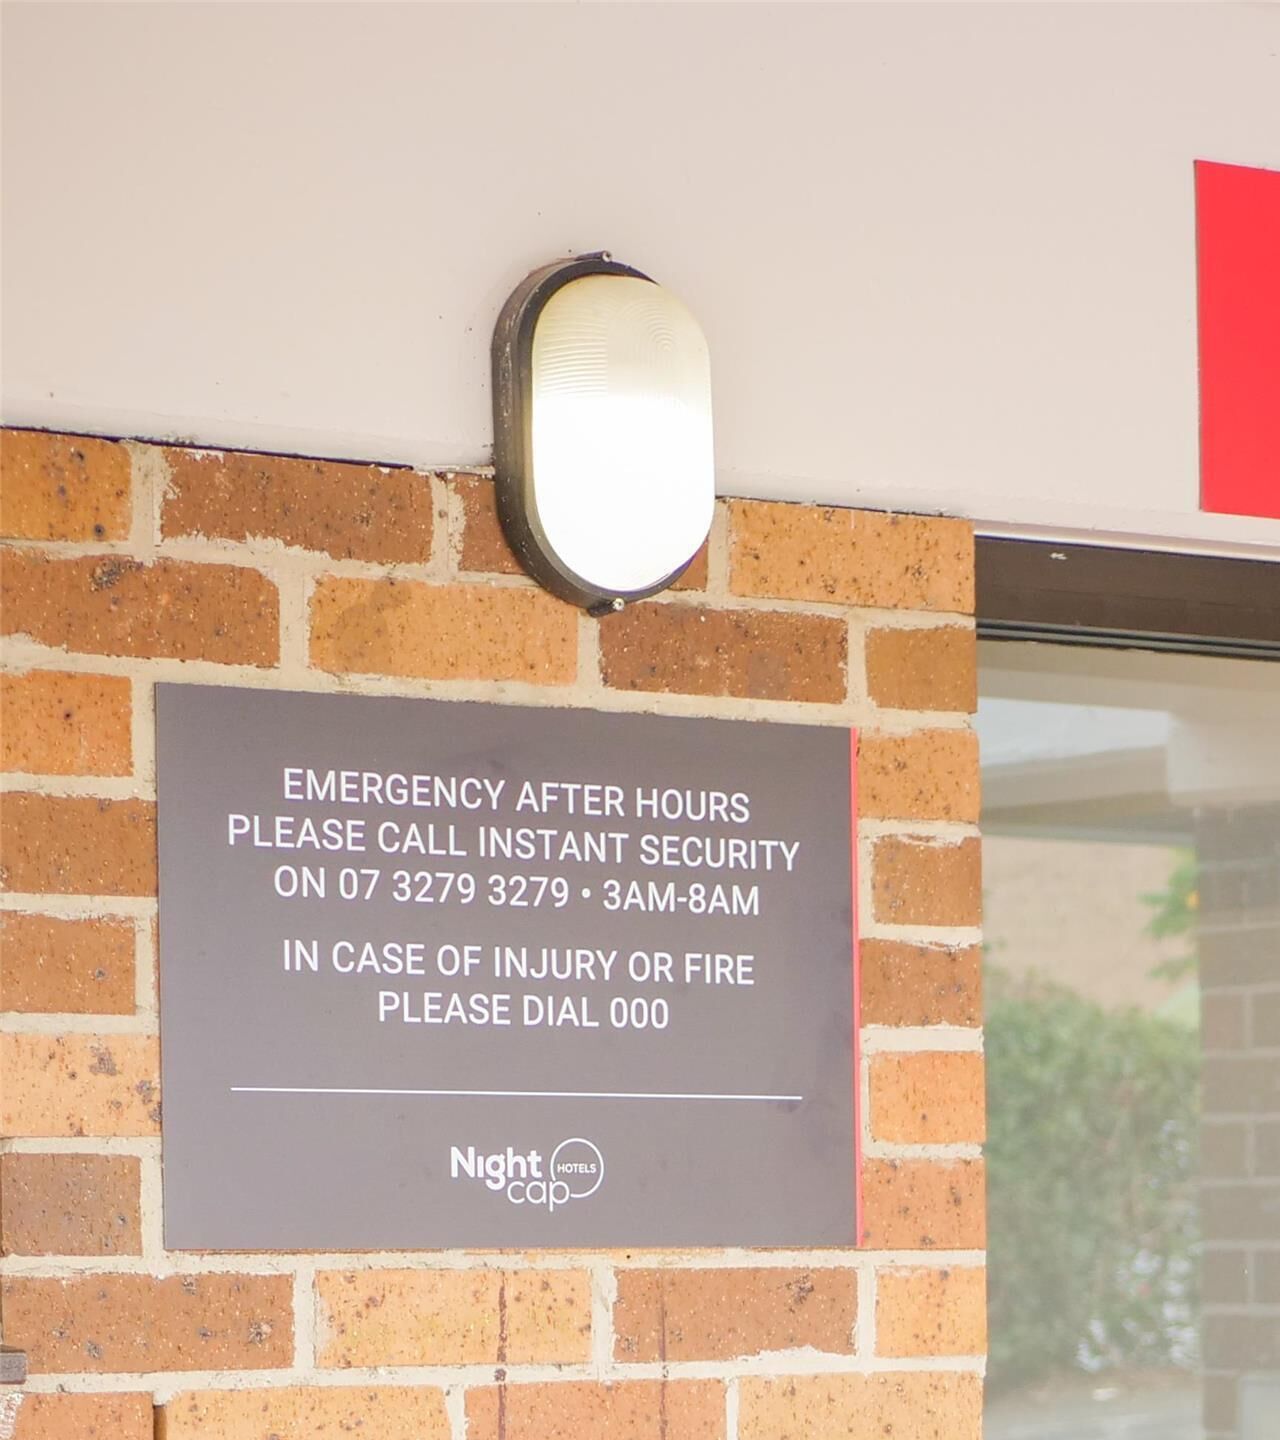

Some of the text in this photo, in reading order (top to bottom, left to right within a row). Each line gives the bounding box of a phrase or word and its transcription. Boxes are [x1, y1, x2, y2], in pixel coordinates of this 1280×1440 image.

[284, 767, 750, 823] EMERGENCY AFTER HOURS
[228, 813, 800, 871] PLEASE CALL INSTANT SECURITY
[274, 865, 759, 916] ON 07 3279 3279 3AM-8AM
[283, 939, 755, 985] IN CASE OF INJURY OR FIRE
[378, 990, 669, 1029] PLEASE DIAL 000
[450, 1146, 542, 1190] Night
[557, 1163, 597, 1174] HOTELS
[507, 1181, 570, 1212] cap
